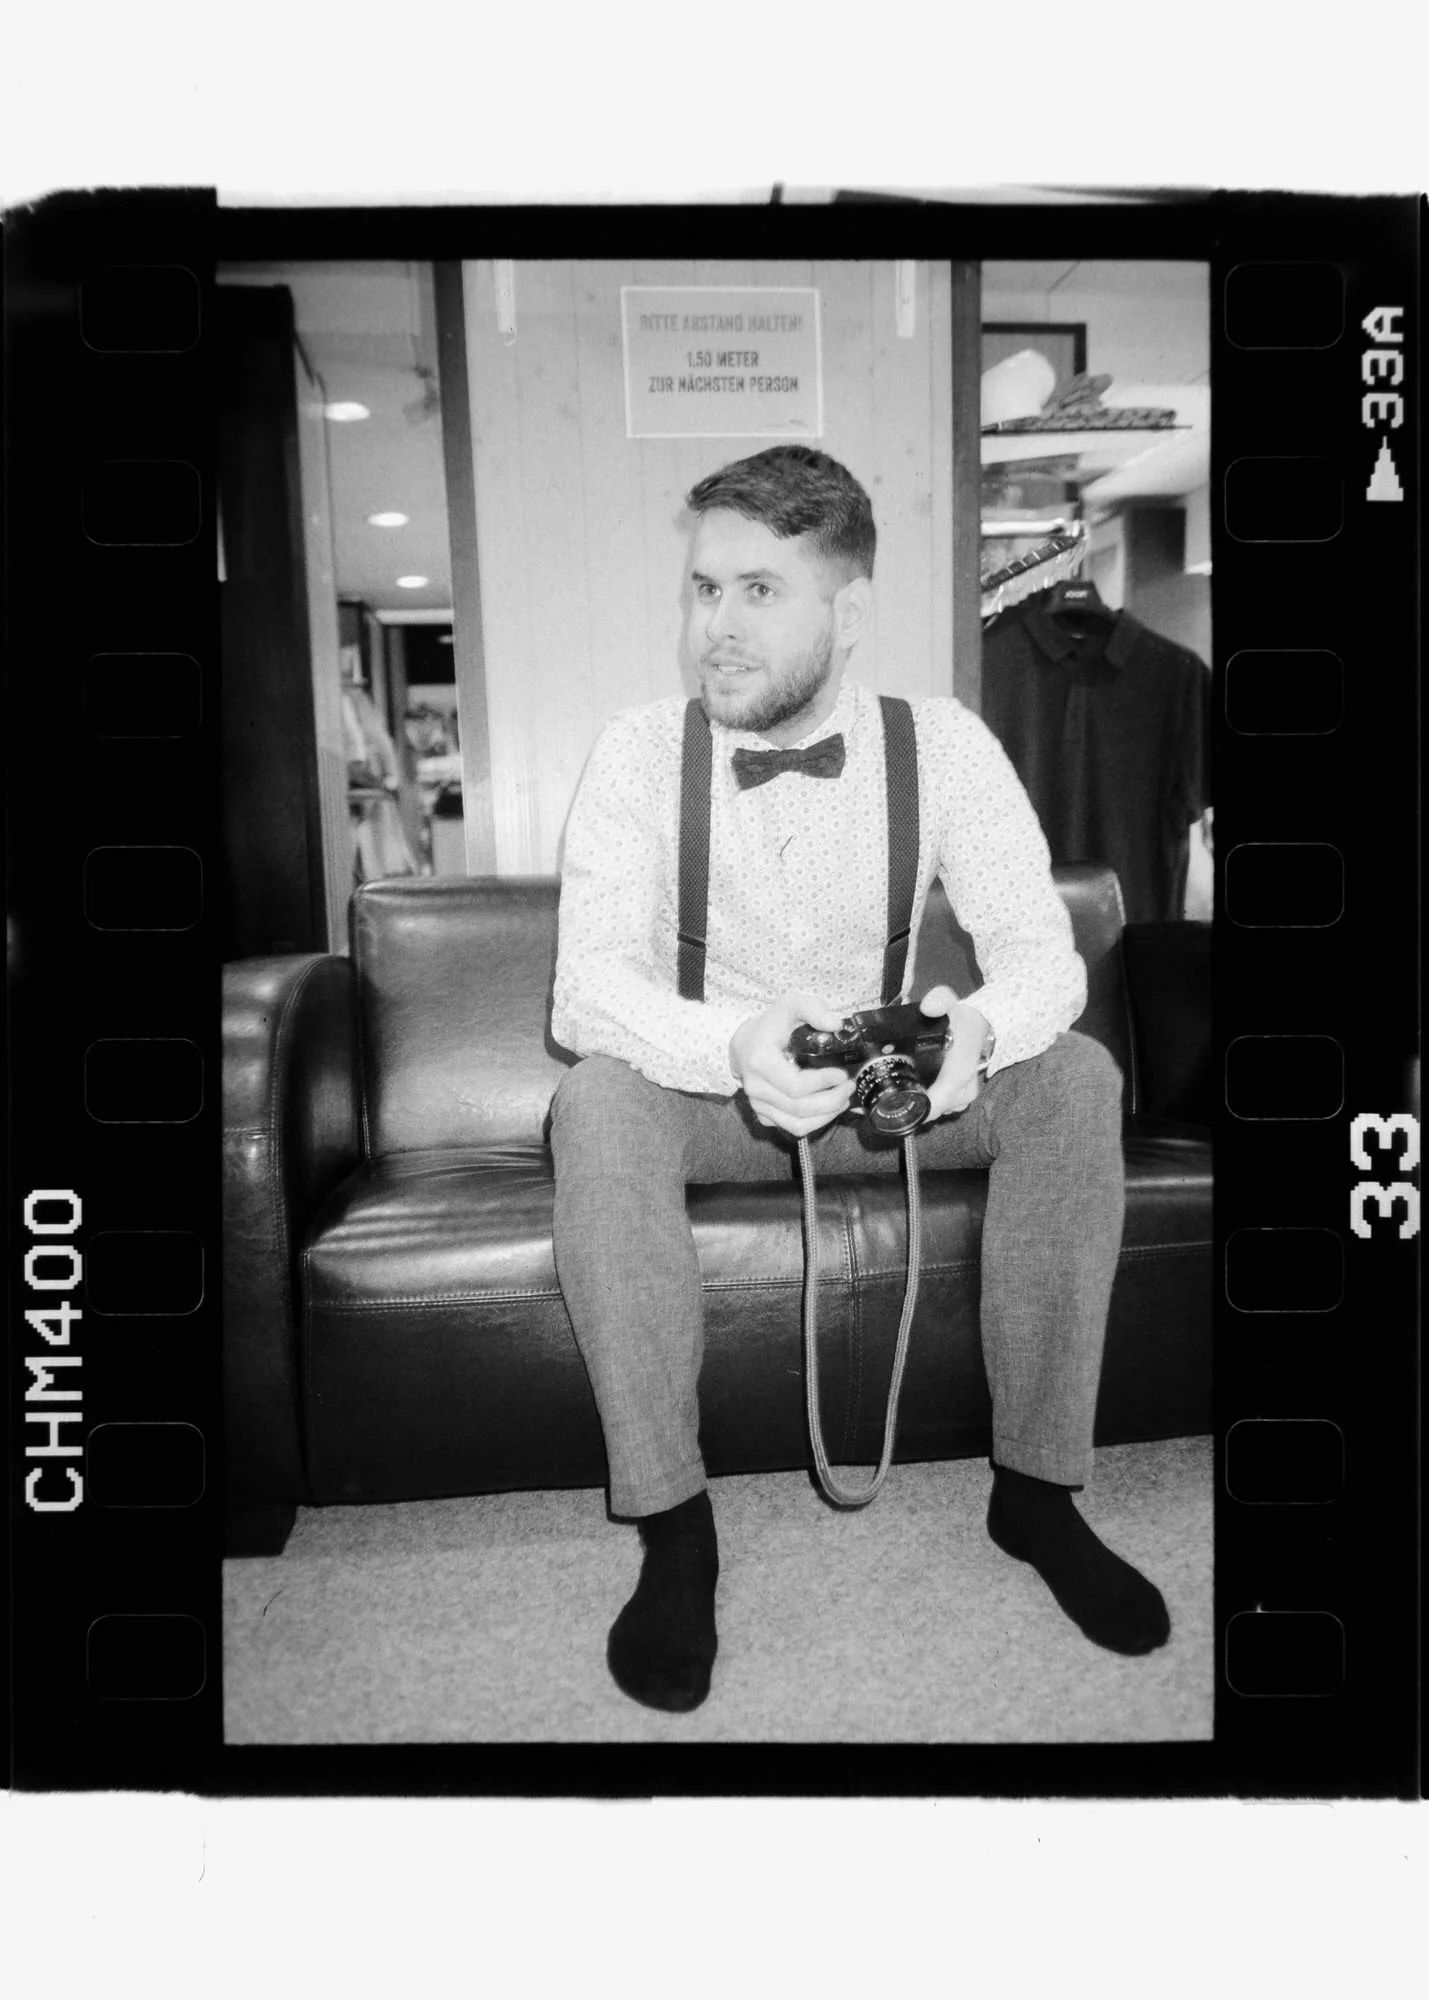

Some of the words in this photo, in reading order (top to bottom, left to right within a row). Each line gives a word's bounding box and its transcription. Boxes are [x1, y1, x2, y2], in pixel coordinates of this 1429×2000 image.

[640, 314, 679, 332] BITTE
[682, 314, 744, 332] ABSTAND
[648, 376, 673, 393] ZUR
[678, 373, 745, 393] NÄCHSTEN
[749, 376, 799, 393] PERSON
[716, 351, 759, 368] METER
[1361, 306, 1404, 428] 33A
[1350, 1113, 1421, 1239] 33
[24, 1189, 83, 1512] CHM400
